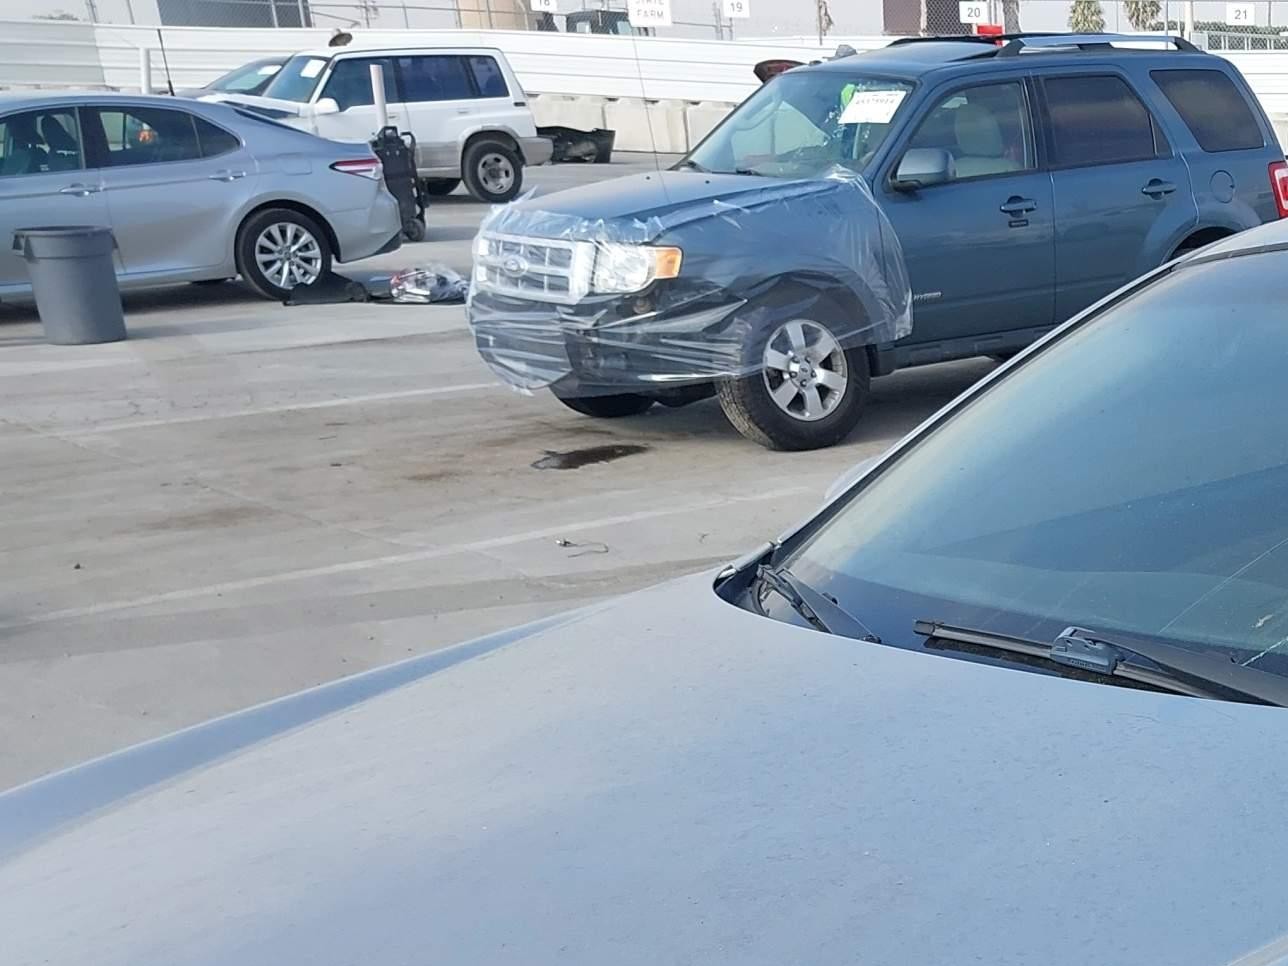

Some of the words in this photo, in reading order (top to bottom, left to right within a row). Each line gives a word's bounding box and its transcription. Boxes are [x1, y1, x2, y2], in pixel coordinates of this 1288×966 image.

[730, 2, 744, 12] 19
[966, 7, 981, 18] 20
[1234, 9, 1248, 20] 21
